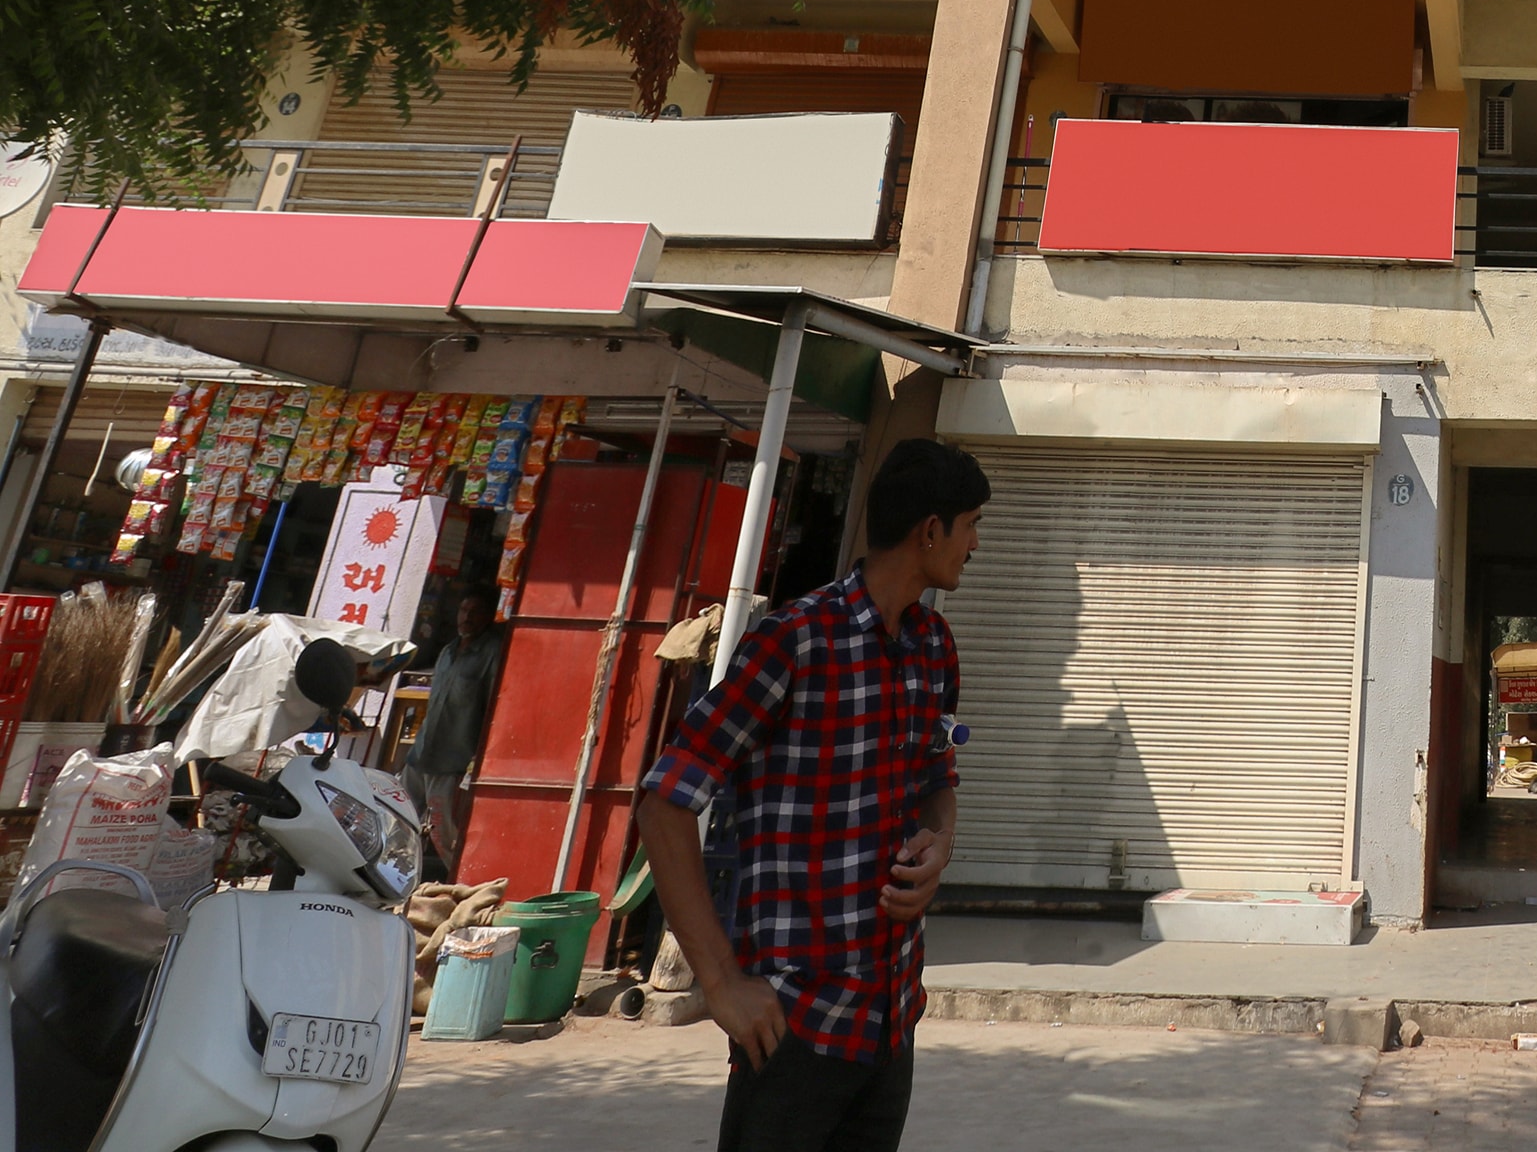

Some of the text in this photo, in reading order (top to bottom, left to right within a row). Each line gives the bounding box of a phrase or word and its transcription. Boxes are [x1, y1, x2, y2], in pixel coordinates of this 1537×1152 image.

[1396, 474, 1405, 483] G
[1392, 486, 1409, 504] 18
[90, 814, 157, 825] MAIZE POHA
[300, 903, 354, 917] HONDA
[306, 1020, 358, 1048] GJ01
[272, 1039, 287, 1048] IND
[286, 1047, 367, 1079] SE7729
